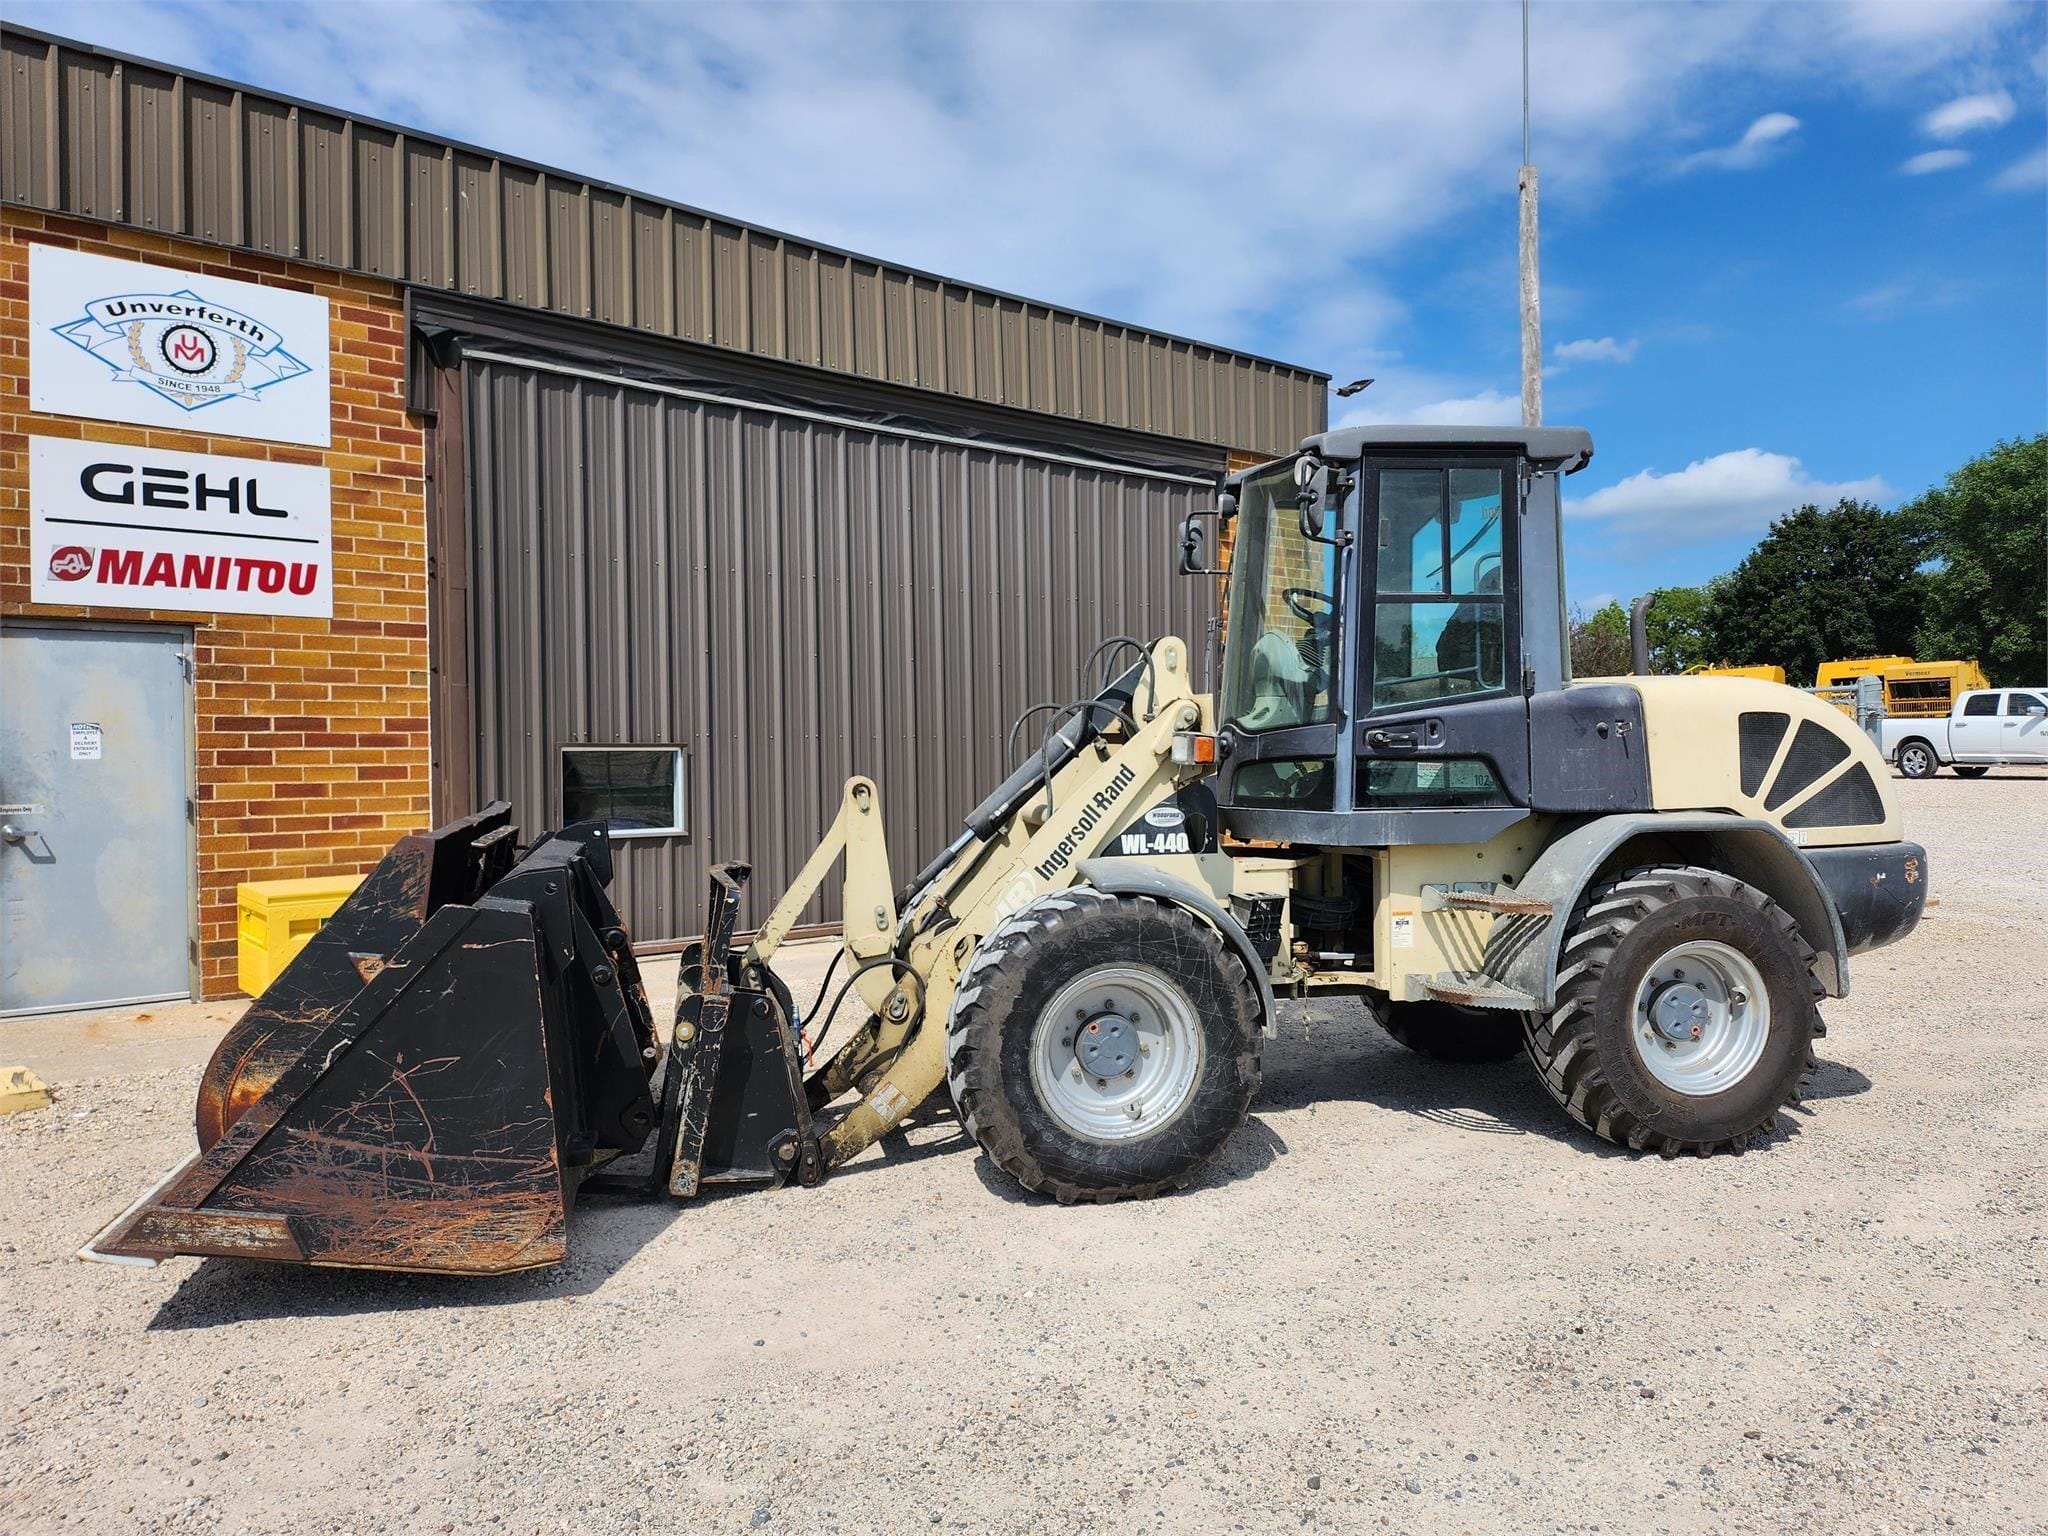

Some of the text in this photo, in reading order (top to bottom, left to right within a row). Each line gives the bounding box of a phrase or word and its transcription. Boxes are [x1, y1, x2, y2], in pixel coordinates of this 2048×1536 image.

[106, 301, 265, 342] Unverferth
[158, 377, 221, 393] SINCE 1948
[80, 463, 288, 519] GEHL
[97, 549, 318, 595] MANITOU
[1474, 775, 1489, 786] 102
[1121, 832, 1190, 855] WL-440
[1680, 911, 1733, 929] MPT
